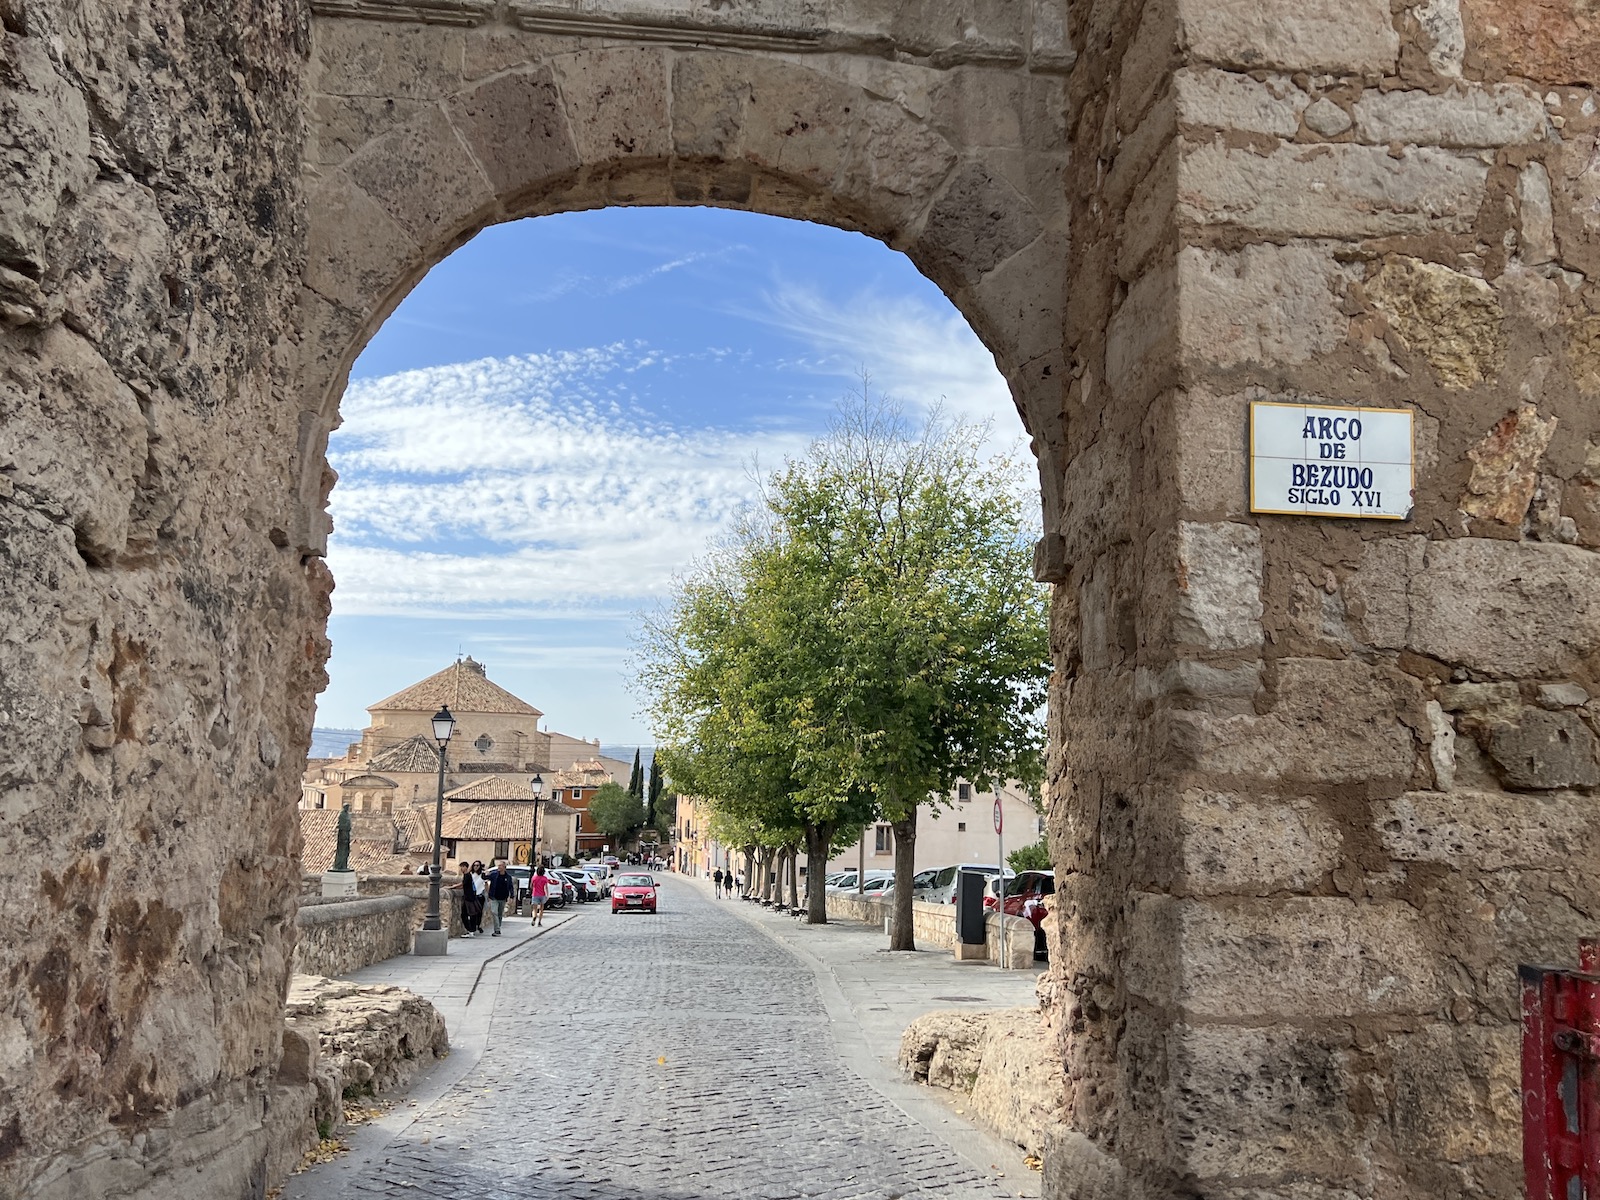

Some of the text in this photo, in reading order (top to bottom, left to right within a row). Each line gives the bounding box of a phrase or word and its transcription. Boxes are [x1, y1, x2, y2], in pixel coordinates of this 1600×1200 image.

[1302, 415, 1362, 441] ARCO
[1319, 442, 1346, 460] DE
[1292, 463, 1373, 490] BEZUDO
[1288, 487, 1382, 508] SIGLO XVI
